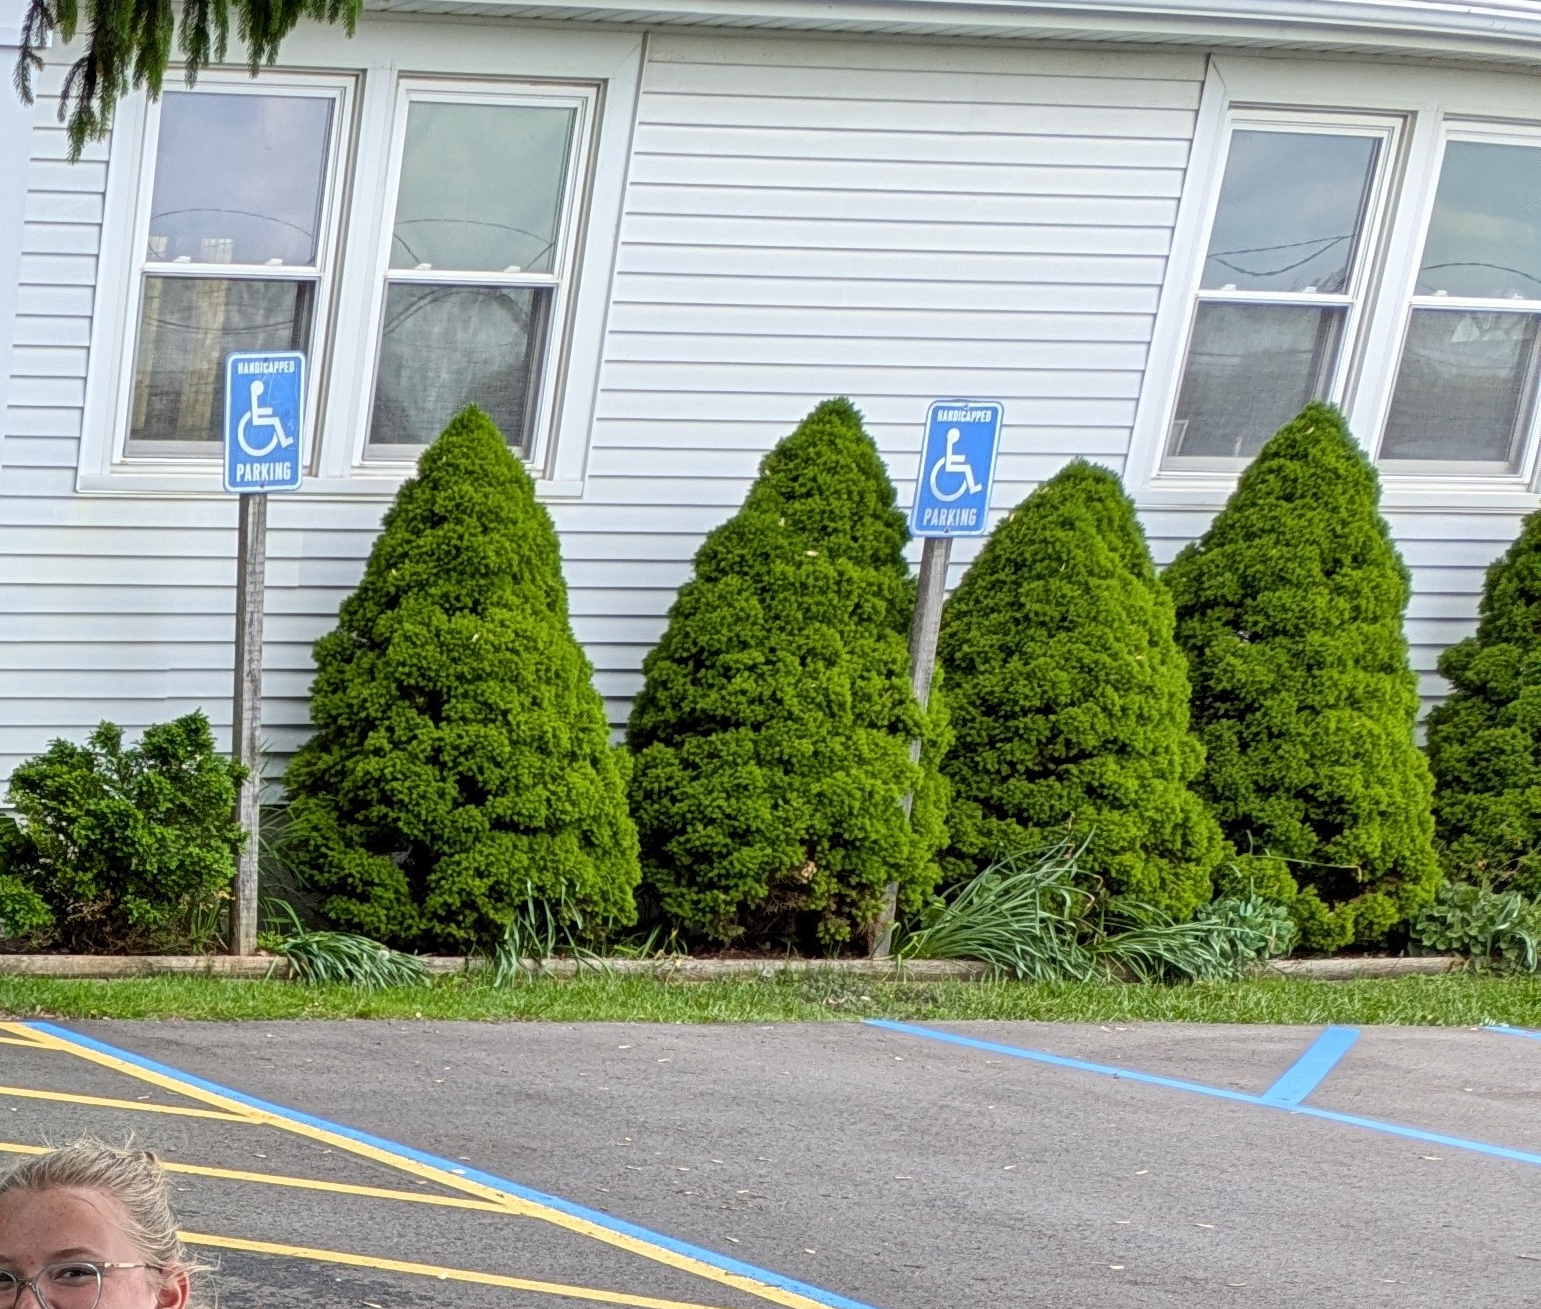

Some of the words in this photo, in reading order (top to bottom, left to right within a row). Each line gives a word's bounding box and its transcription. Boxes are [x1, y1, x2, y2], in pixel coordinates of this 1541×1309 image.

[237, 360, 295, 374] HANDICAPPED
[937, 409, 992, 422] HANDICAPPED
[236, 461, 292, 482] PARKING
[923, 508, 977, 526] PARKING
